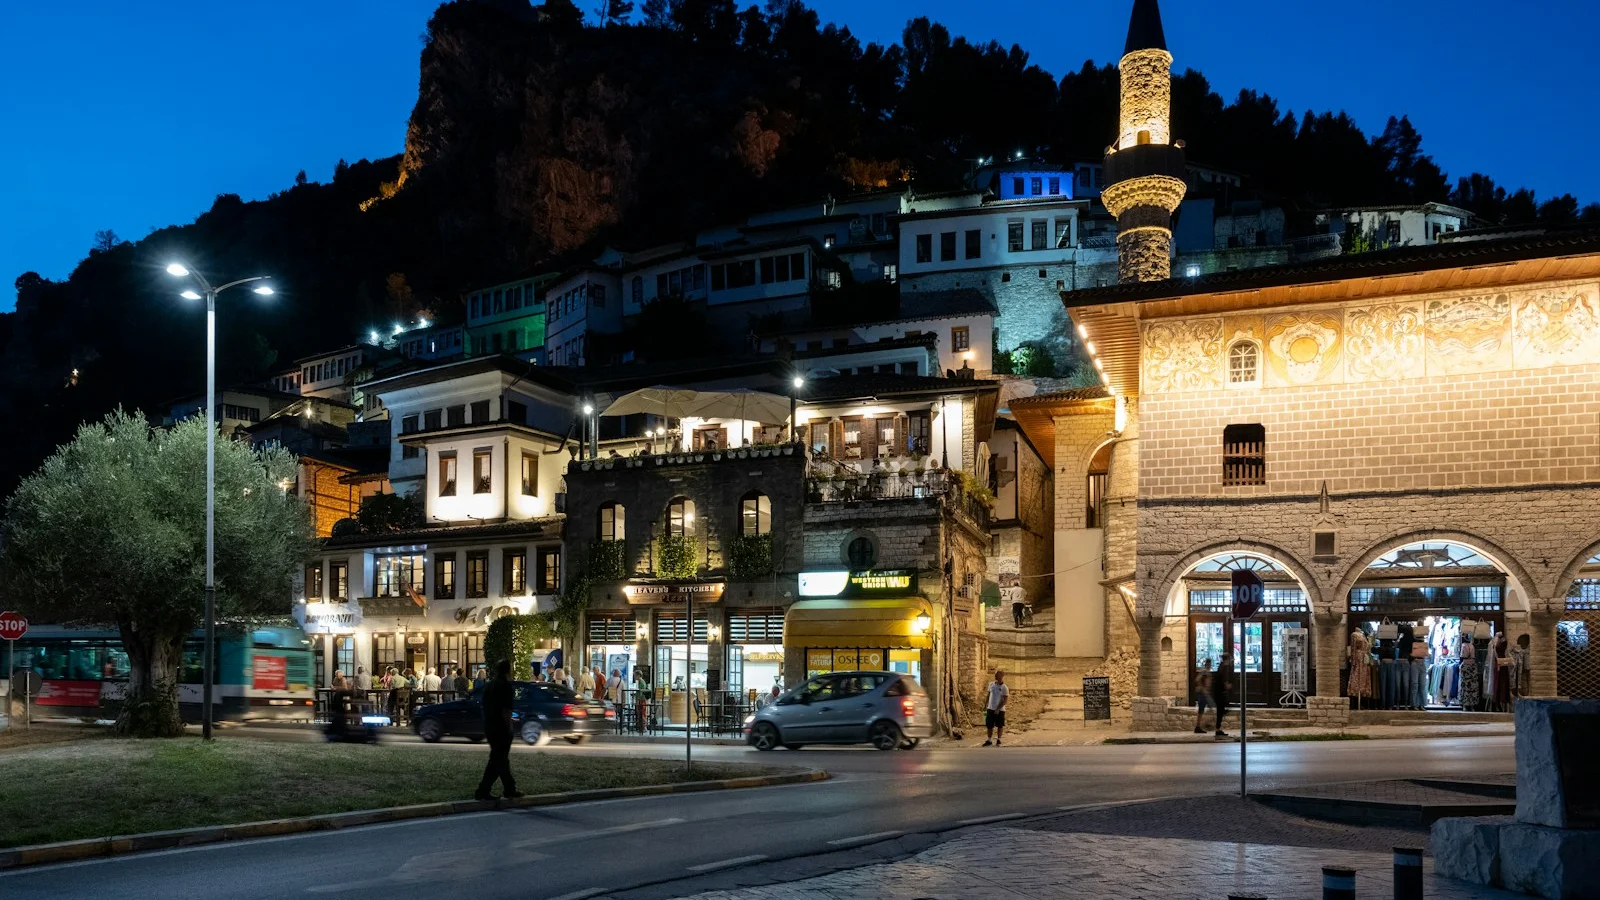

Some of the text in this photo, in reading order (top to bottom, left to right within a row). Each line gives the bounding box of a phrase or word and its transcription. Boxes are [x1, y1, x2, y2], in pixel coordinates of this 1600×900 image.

[679, 585, 716, 593] KITCHEN
[1232, 584, 1260, 604] TOP
[0, 620, 25, 631] STOP
[838, 655, 870, 665] OSHEE
